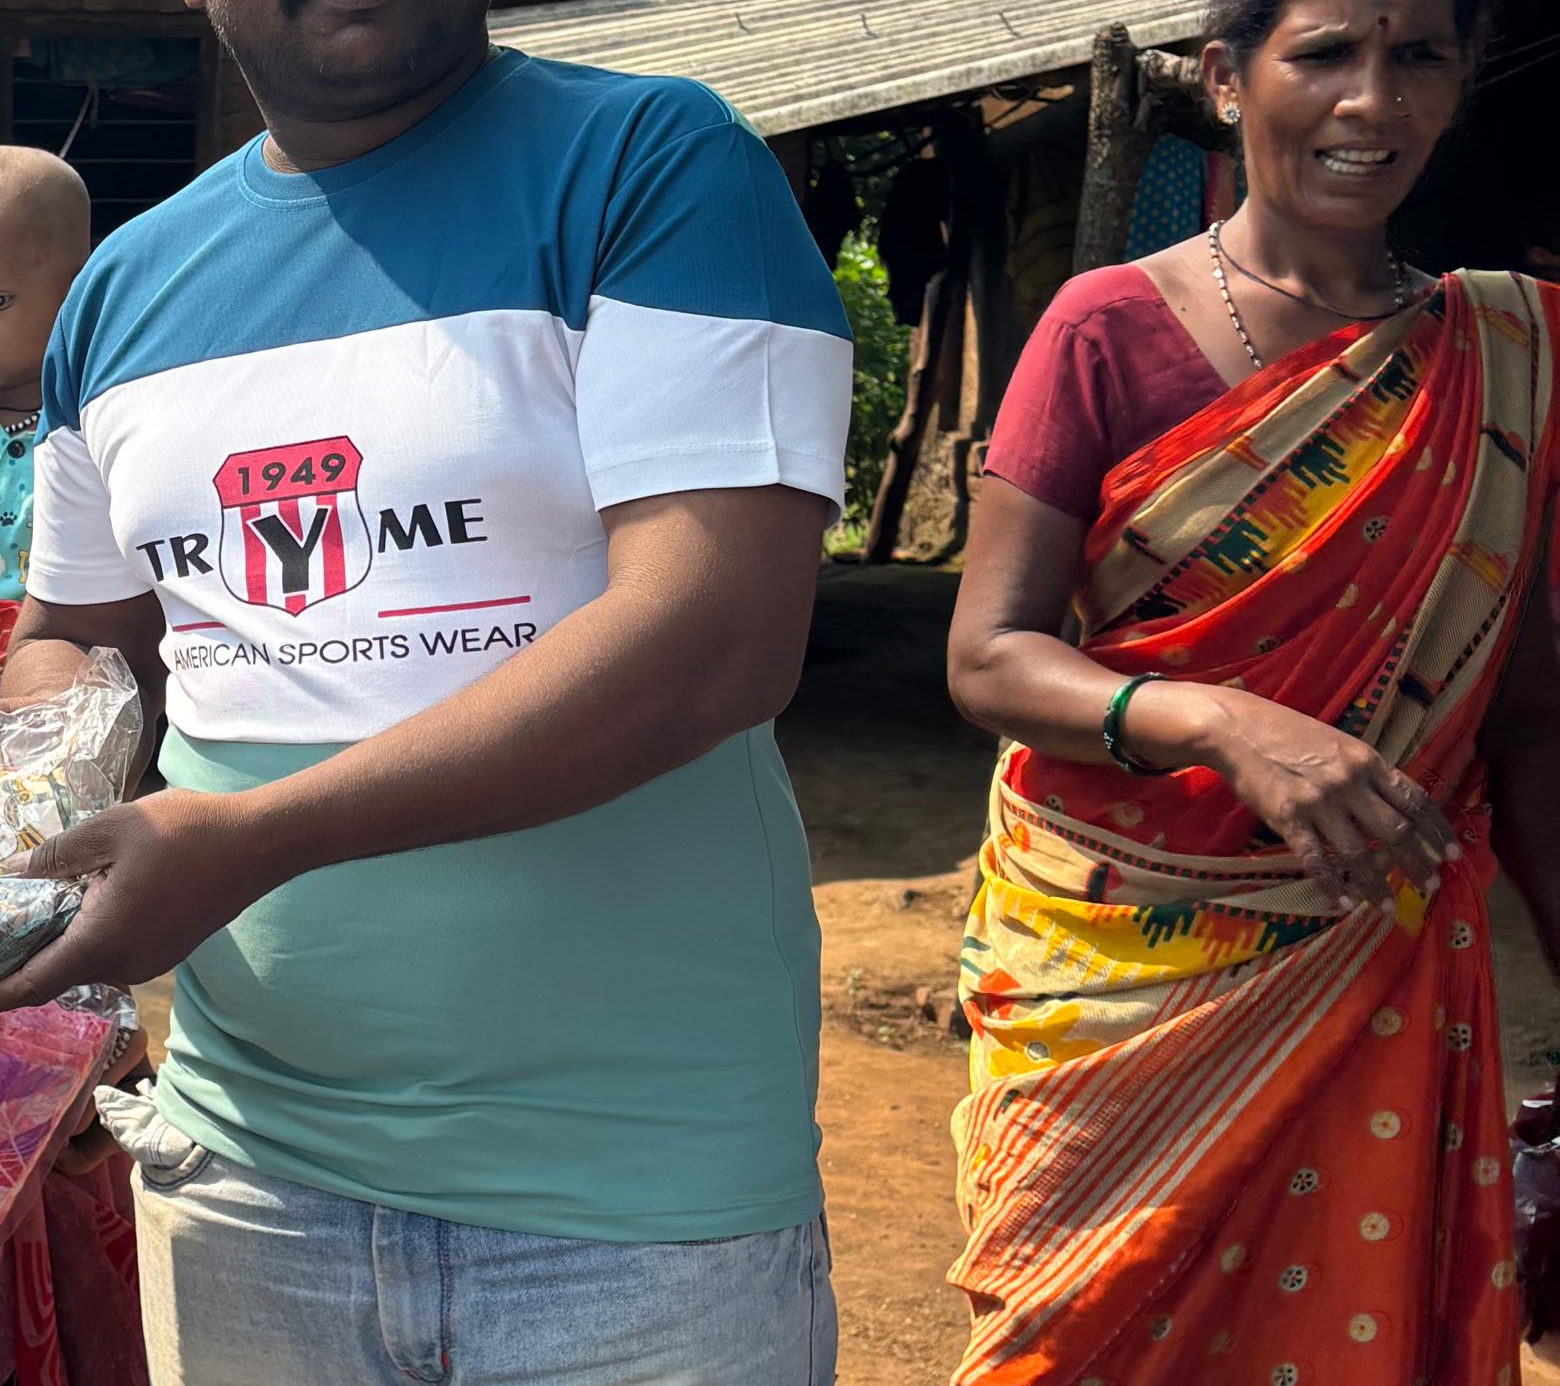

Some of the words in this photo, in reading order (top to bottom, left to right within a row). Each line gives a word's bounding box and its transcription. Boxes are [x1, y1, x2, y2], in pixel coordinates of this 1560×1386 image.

[236, 452, 346, 495] 1949
[378, 498, 488, 553] ME
[174, 643, 271, 671] AMERICAN
[278, 634, 410, 664] SPORTS
[419, 622, 537, 656] WEAR
